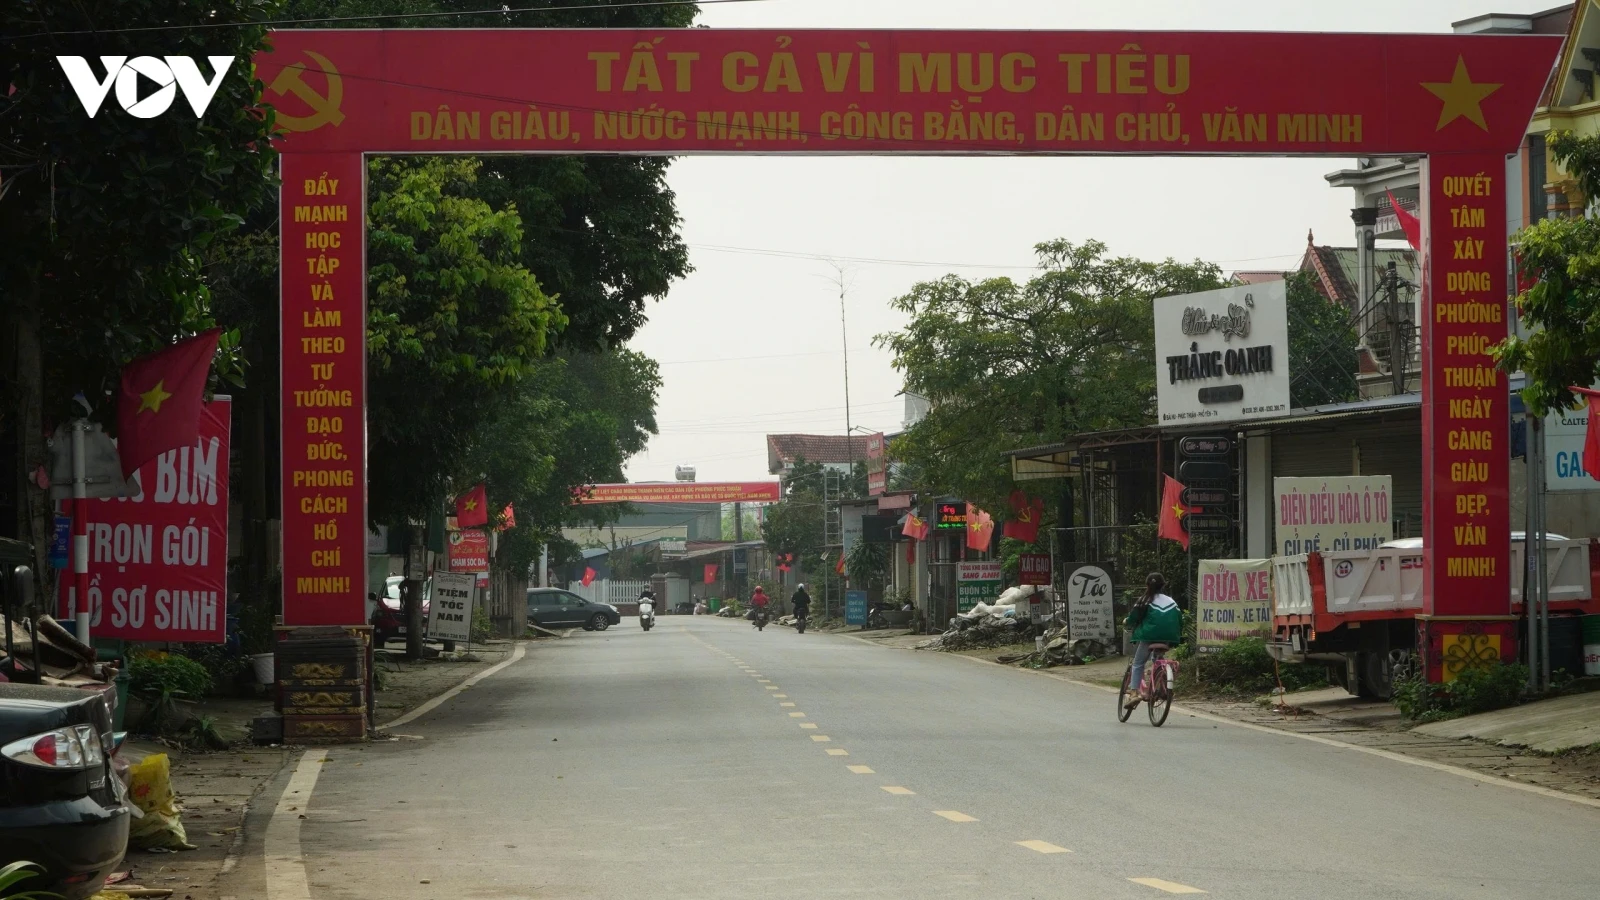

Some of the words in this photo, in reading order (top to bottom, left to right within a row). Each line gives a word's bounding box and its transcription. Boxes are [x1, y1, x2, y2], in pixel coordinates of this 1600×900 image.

[587, 36, 699, 92] TẤT
[721, 36, 803, 92] CẢ
[817, 42, 874, 92] VÌ
[899, 52, 1036, 103] MỤC
[1058, 44, 1190, 93] TIÊU
[410, 104, 480, 140] DÂN
[489, 105, 580, 144] GIÀU,
[594, 103, 686, 140] NƯỚC
[697, 111, 808, 147] MẠNH,
[820, 104, 913, 141] CÔNG
[923, 100, 1025, 143] BẰNG,
[1035, 105, 1103, 141] DÂN
[1115, 102, 1190, 144] CHỦ,
[1203, 107, 1267, 142] VĂN
[1277, 114, 1363, 143] MINH
[304, 172, 339, 196] ĐẨY
[1443, 172, 1492, 198] QUYẾT
[294, 205, 348, 225] MẠNH
[1450, 205, 1486, 228] TÂM
[306, 232, 341, 252] HỌC
[1453, 237, 1485, 260] XÂY
[307, 254, 340, 277] TẬP
[311, 281, 334, 301] VÀ
[1447, 271, 1491, 295] DỰNG
[304, 308, 341, 328] LÀM
[1436, 299, 1502, 323] PHƯỜNG
[301, 337, 345, 354] THEO
[1447, 333, 1490, 355] PHÚC
[311, 362, 335, 381] TƯ
[1166, 341, 1223, 385] THẮNG
[1224, 345, 1274, 376] OANH
[1443, 365, 1497, 390] THUẬN
[294, 384, 352, 407] TƯỞNG
[1450, 395, 1492, 419] NGÀY
[307, 416, 343, 437] ĐẠO
[1448, 427, 1492, 451] CÀNG
[307, 440, 348, 462] ĐỨC,
[1451, 458, 1489, 482] GIÀU
[1556, 451, 1586, 478] GA
[293, 470, 354, 487] PHONG
[301, 494, 348, 514] CÁCH
[1281, 487, 1307, 533] ĐIỆN
[1364, 485, 1372, 524] Ô
[1374, 485, 1388, 523] TÔ
[1456, 494, 1490, 517] ĐẸP,
[314, 518, 338, 540] HỒ
[1453, 522, 1487, 546] VĂN
[86, 522, 153, 573] TRỌN
[162, 518, 209, 566] GÓI
[311, 547, 341, 567] CHÍ
[1021, 555, 1035, 572] XÁT
[1035, 557, 1049, 575] GẠO
[1447, 557, 1496, 577] MINH!
[297, 576, 350, 594] MINH!
[437, 587, 468, 600] TIỆM
[1072, 572, 1108, 599] Tóc
[1202, 563, 1240, 602] RỬA
[1245, 570, 1270, 601] XE
[111, 585, 147, 629] SƠ
[154, 588, 217, 631] SINH
[439, 600, 464, 610] TÓC
[1202, 609, 1214, 622] XE
[1216, 609, 1235, 623] CON
[1243, 608, 1254, 622] XE
[1256, 602, 1270, 622] TẢI
[436, 612, 464, 622] NAM
